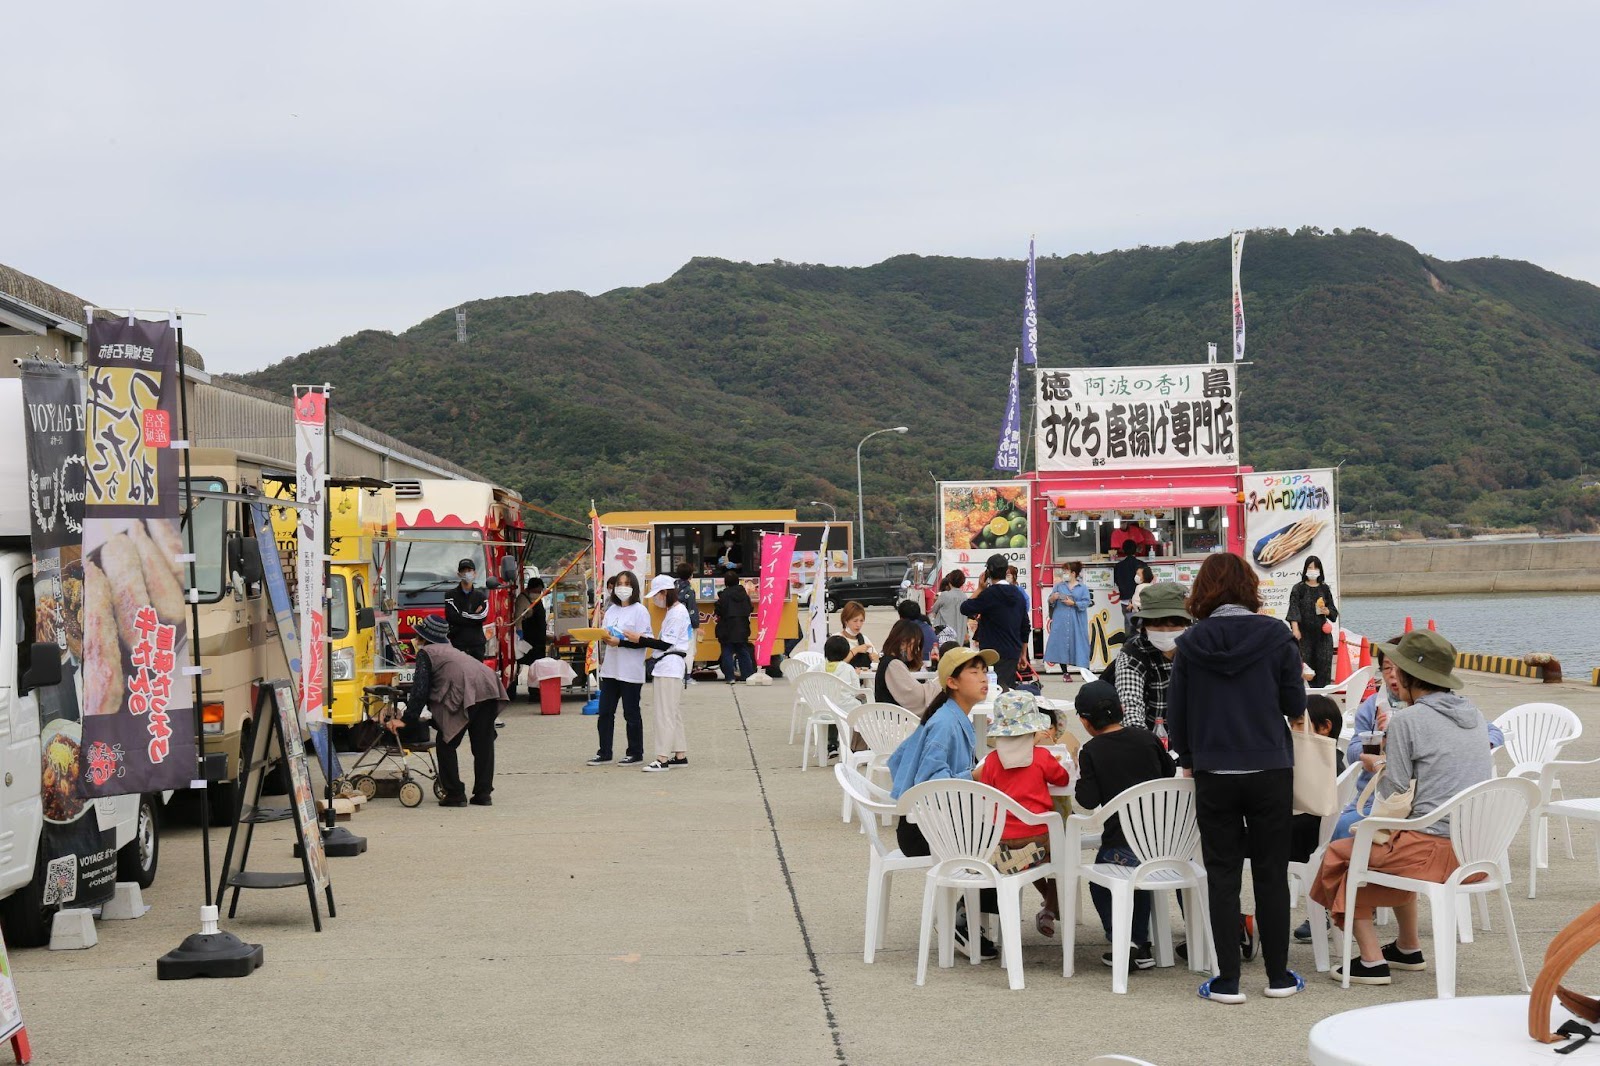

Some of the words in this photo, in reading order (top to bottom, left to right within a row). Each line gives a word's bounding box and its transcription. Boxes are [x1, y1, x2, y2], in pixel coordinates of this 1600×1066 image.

[1041, 371, 1073, 401] 徳
[1084, 373, 1192, 397] 阿波の香り
[1203, 368, 1232, 398] 島
[28, 402, 86, 433] VOYAGE
[1248, 485, 1331, 512] スーパーロングポテト
[615, 546, 638, 570] モ
[756, 541, 783, 660] ライスバーガー
